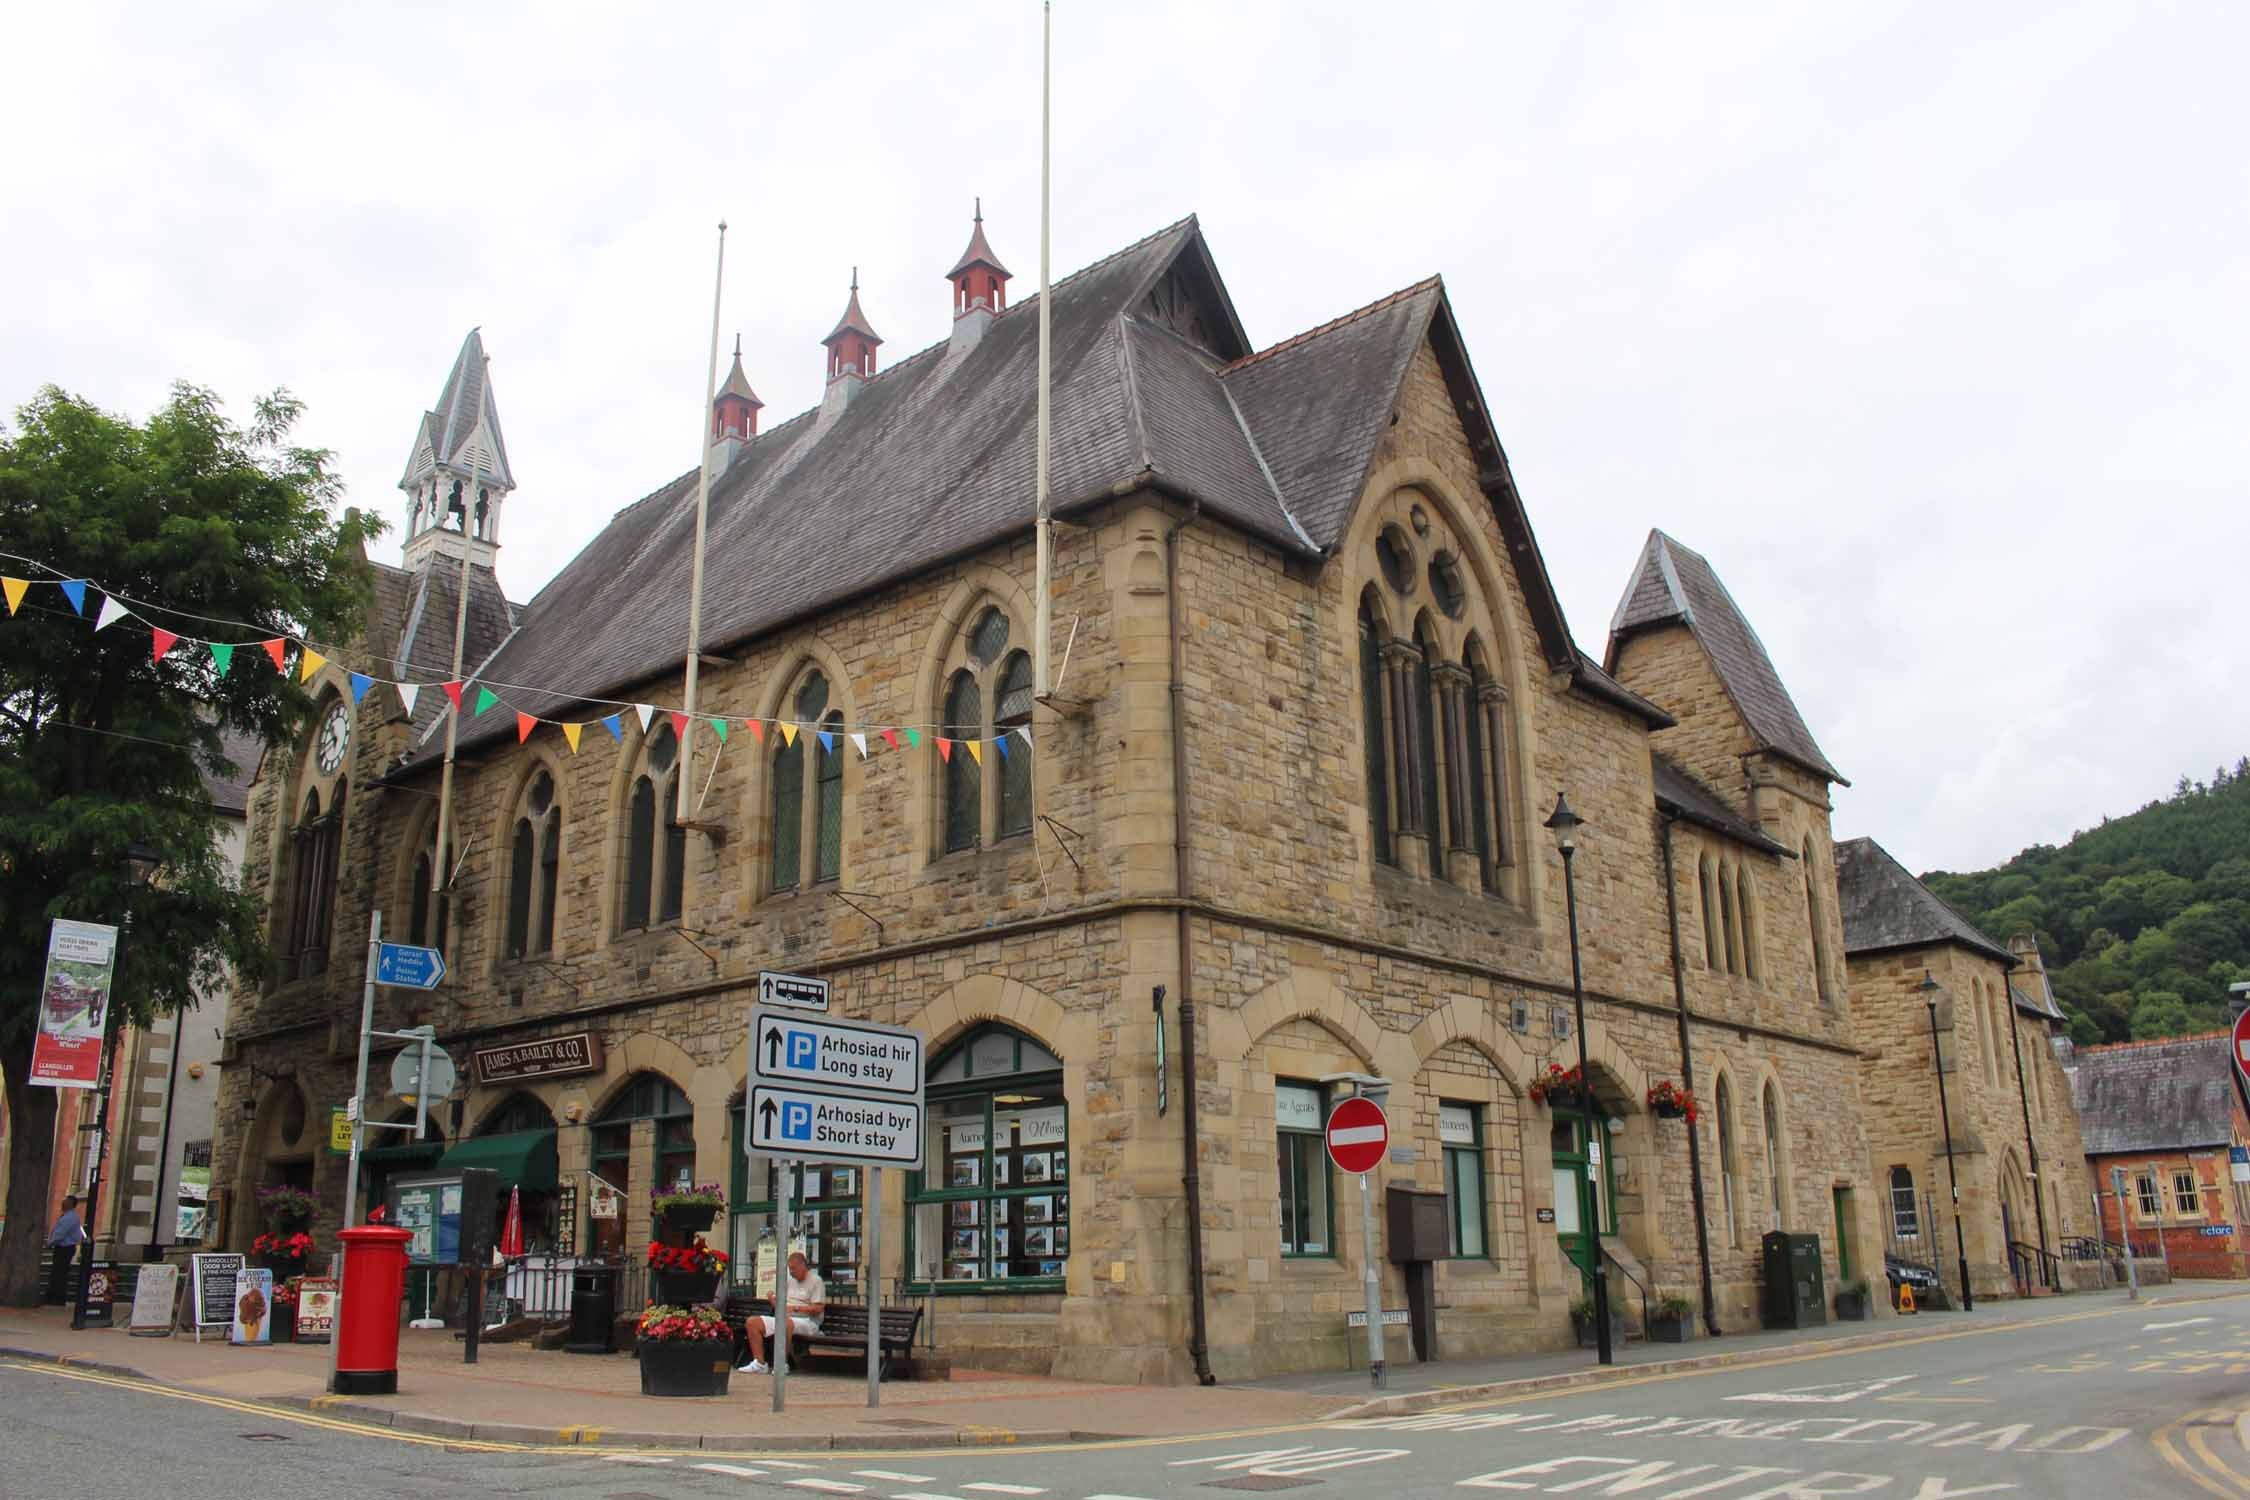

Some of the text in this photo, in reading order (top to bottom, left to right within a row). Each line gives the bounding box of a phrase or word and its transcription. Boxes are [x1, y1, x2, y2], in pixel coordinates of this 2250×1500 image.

[484, 1052, 512, 1071] JAMES
[556, 1043, 565, 1058] &
[566, 1040, 582, 1058] CO.
[794, 1035, 911, 1065] P Arhosiad hir
[822, 1056, 893, 1082] Long stay
[789, 1105, 911, 1136] P Arhosiad byr
[1290, 1097, 1315, 1115] Agents
[816, 1125, 896, 1150] Short stay
[1513, 1413, 2132, 1454] MYNEDIAD
[1167, 1446, 2021, 1500] NO ENTRY
